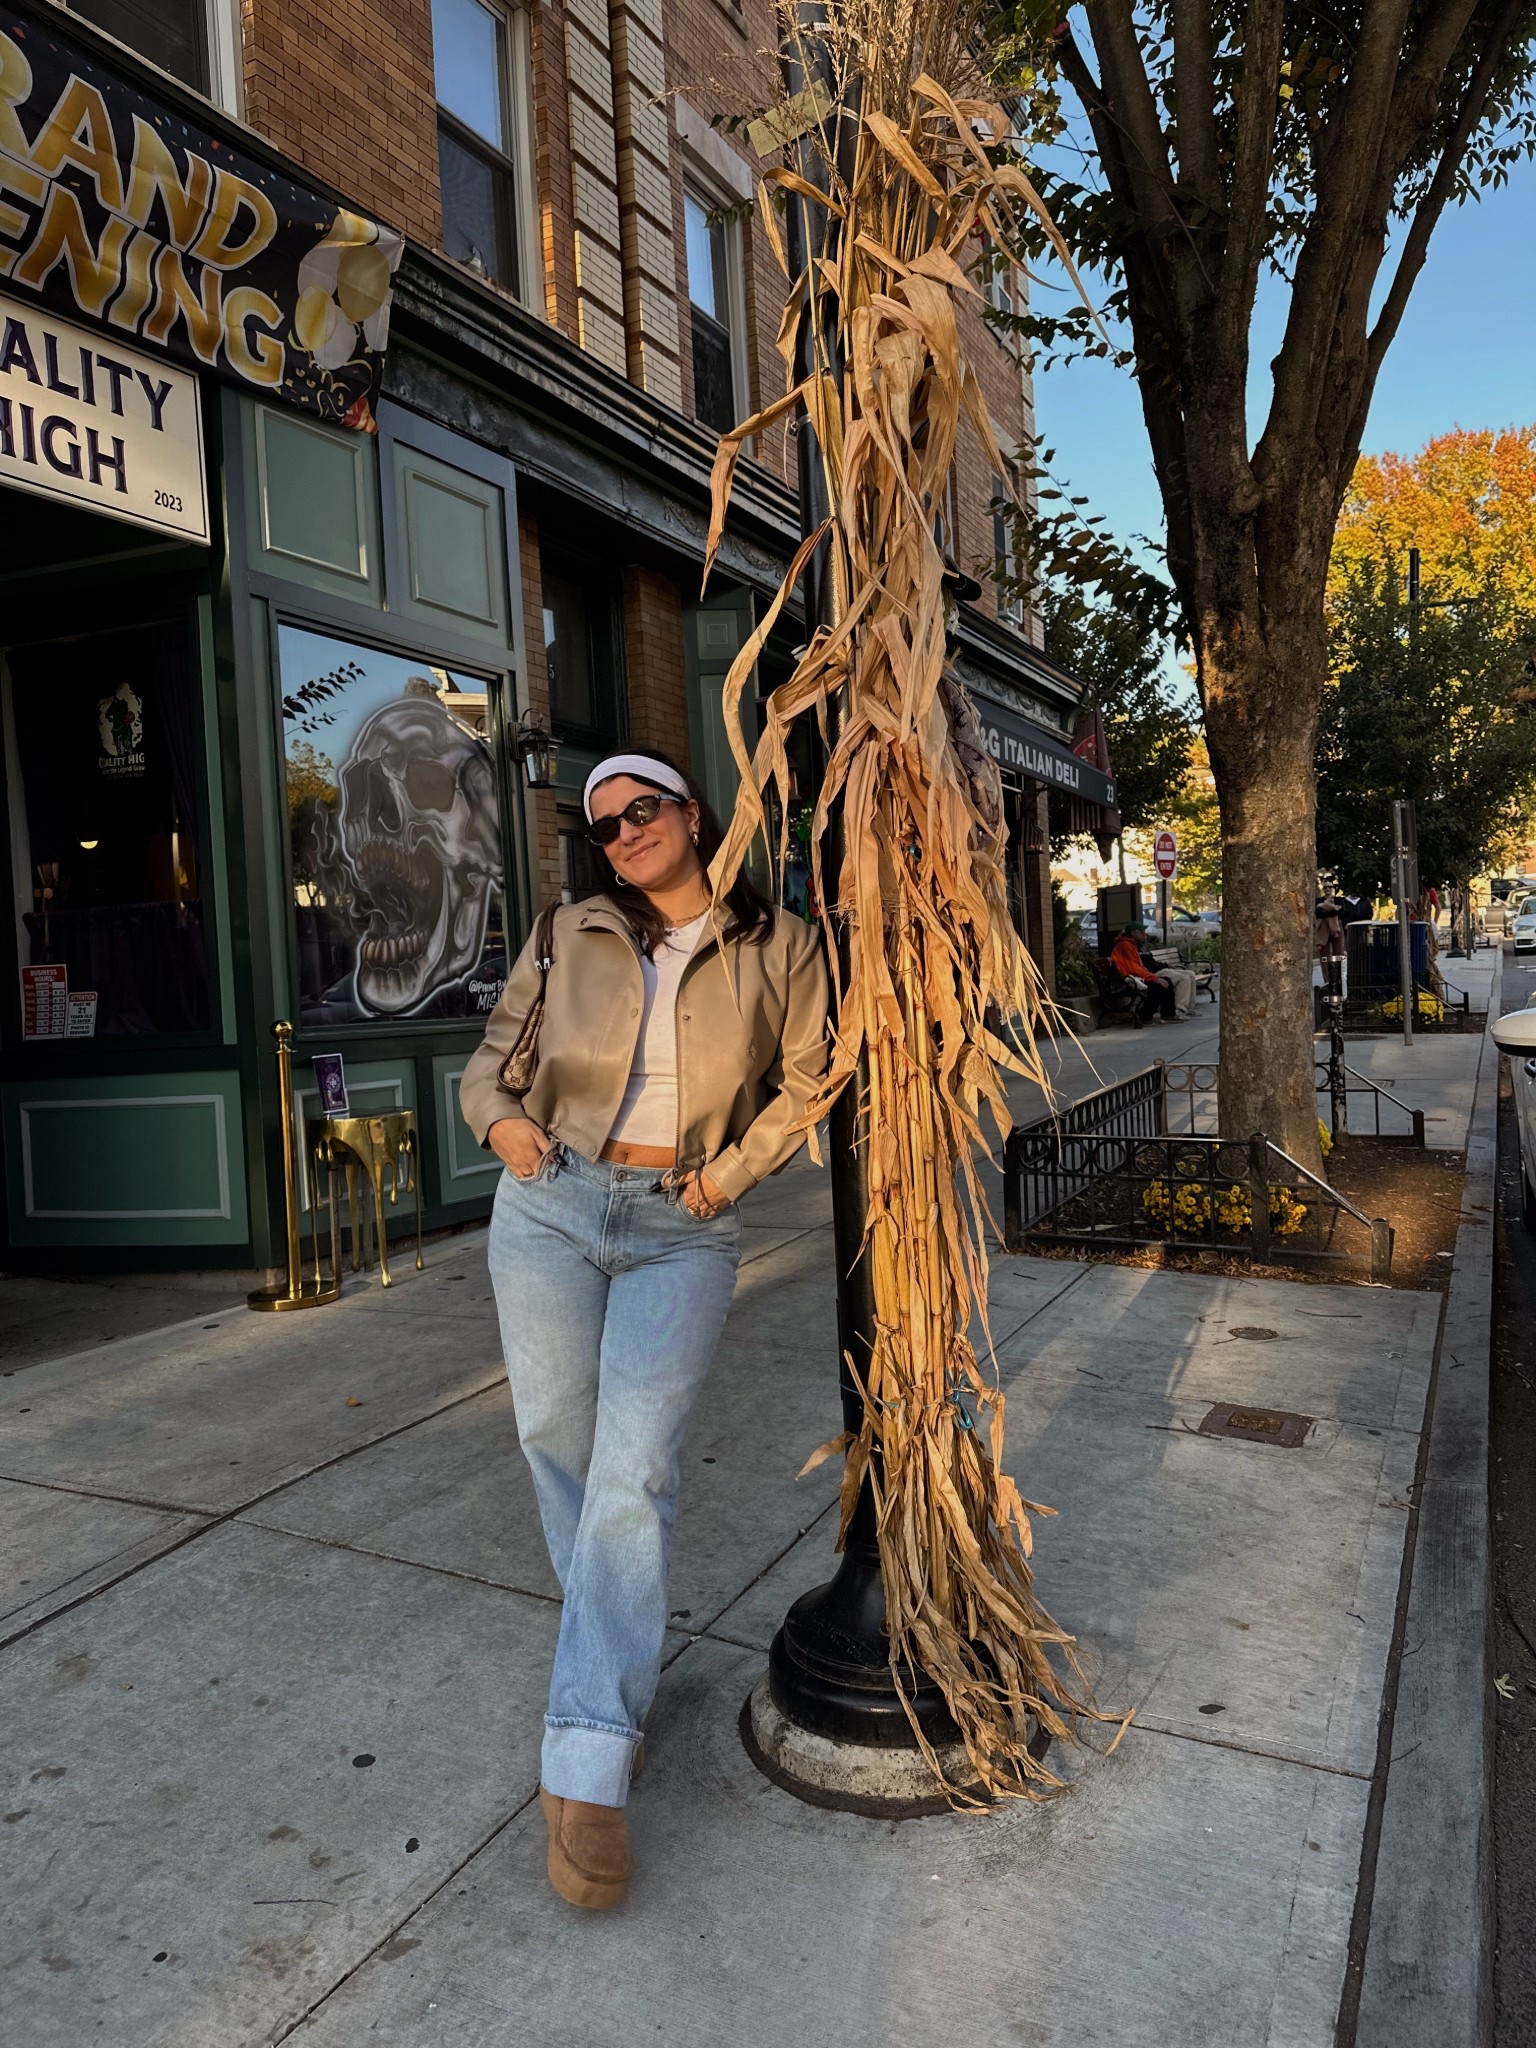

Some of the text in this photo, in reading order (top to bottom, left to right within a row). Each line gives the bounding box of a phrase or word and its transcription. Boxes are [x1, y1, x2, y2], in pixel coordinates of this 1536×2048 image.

[154, 490, 183, 512] 2023
[1004, 736, 1053, 778] ITALIAN
[1055, 759, 1079, 789] DELI
[1106, 784, 1114, 803] 23
